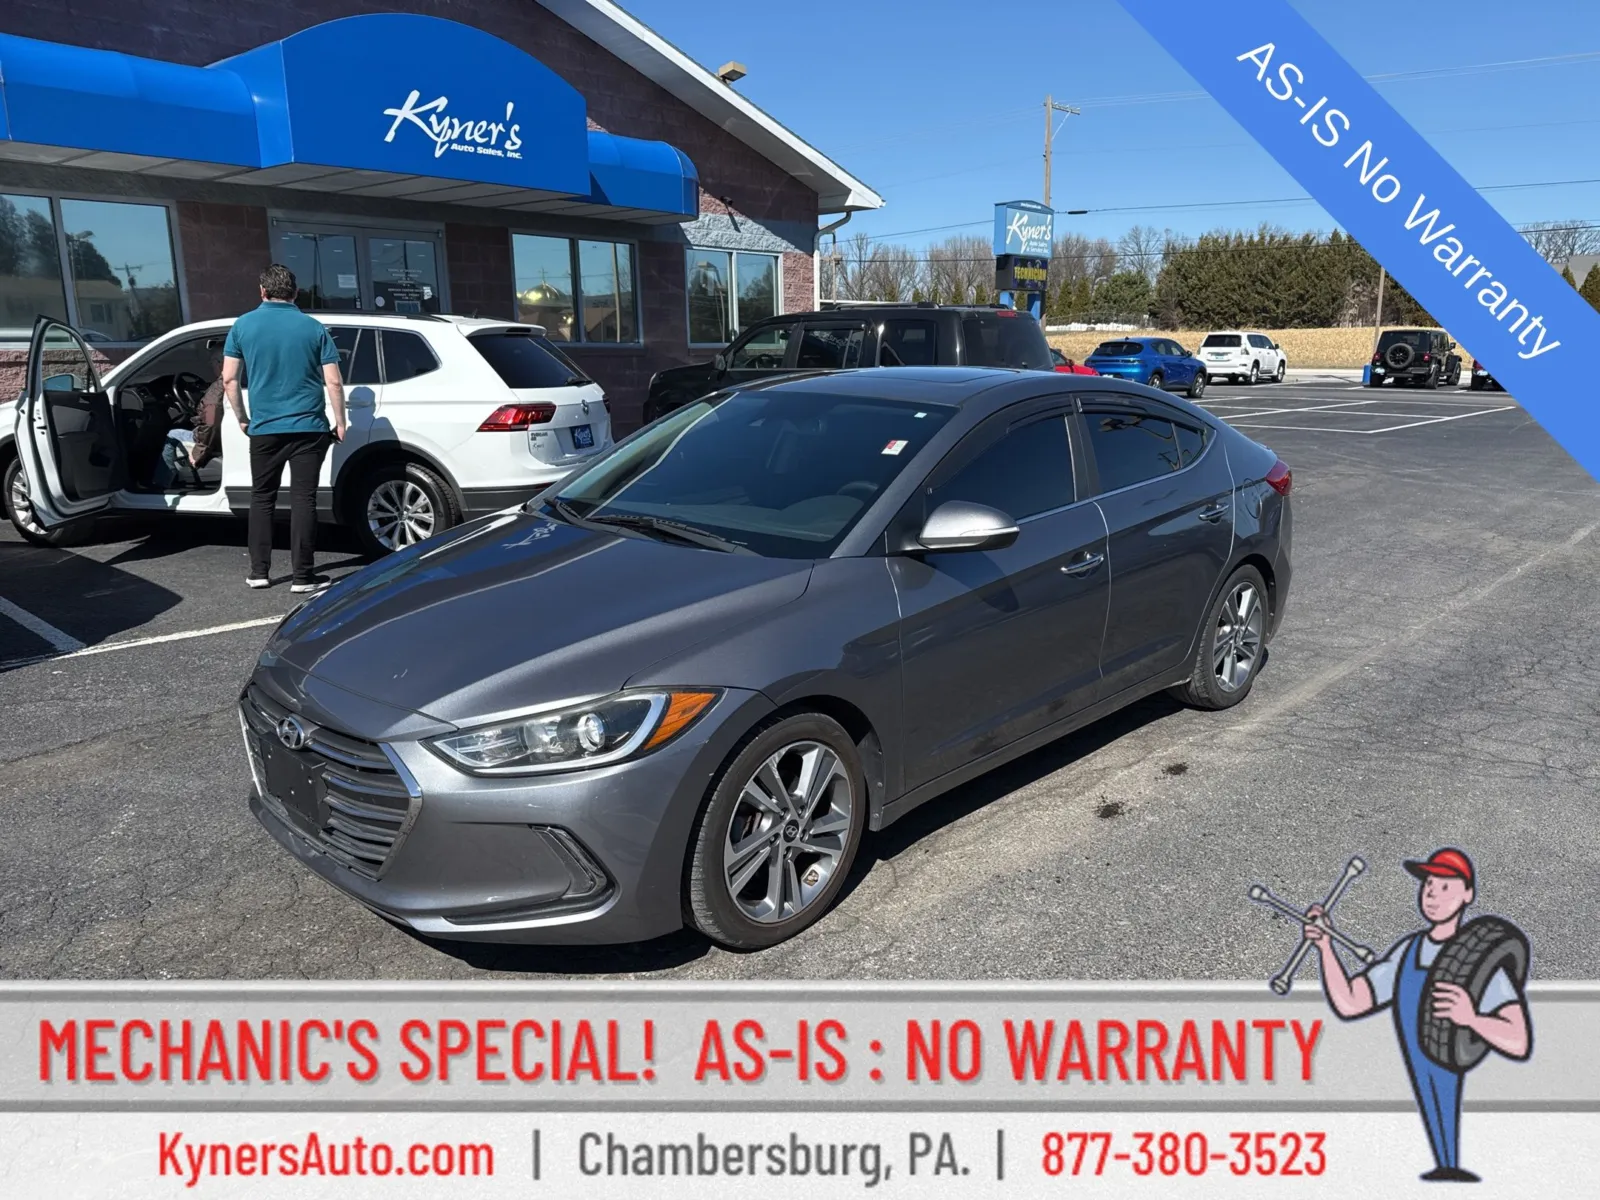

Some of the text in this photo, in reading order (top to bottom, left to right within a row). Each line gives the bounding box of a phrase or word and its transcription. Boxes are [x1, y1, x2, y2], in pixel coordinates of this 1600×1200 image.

[383, 89, 522, 158] Kyner's
[451, 143, 475, 153] Auto
[1006, 212, 1051, 254] Kyner's
